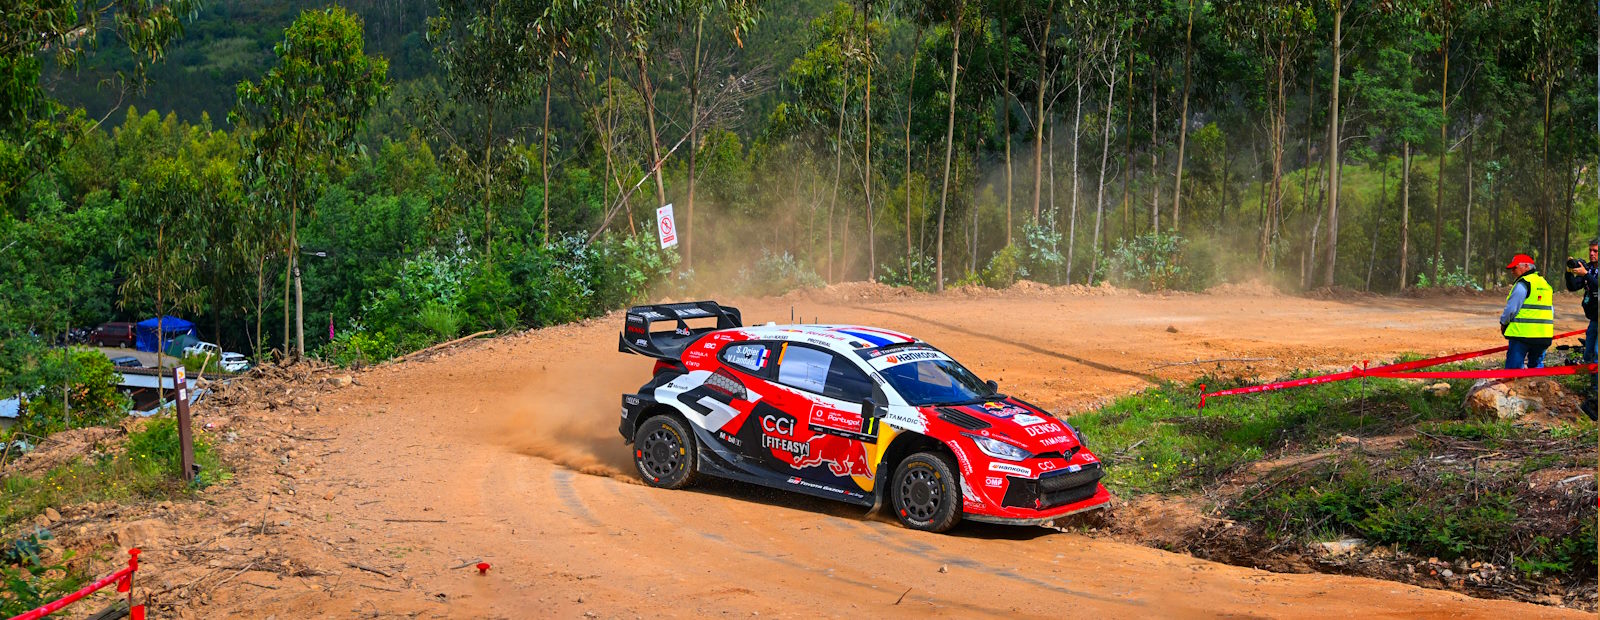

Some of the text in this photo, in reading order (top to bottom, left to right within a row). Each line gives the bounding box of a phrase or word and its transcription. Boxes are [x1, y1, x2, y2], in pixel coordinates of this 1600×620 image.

[827, 414, 860, 426] Portugal
[889, 413, 919, 424] TAMADIC
[867, 416, 875, 435] 1
[1025, 422, 1061, 437] DENSO
[1039, 435, 1070, 447] TAMADIC
